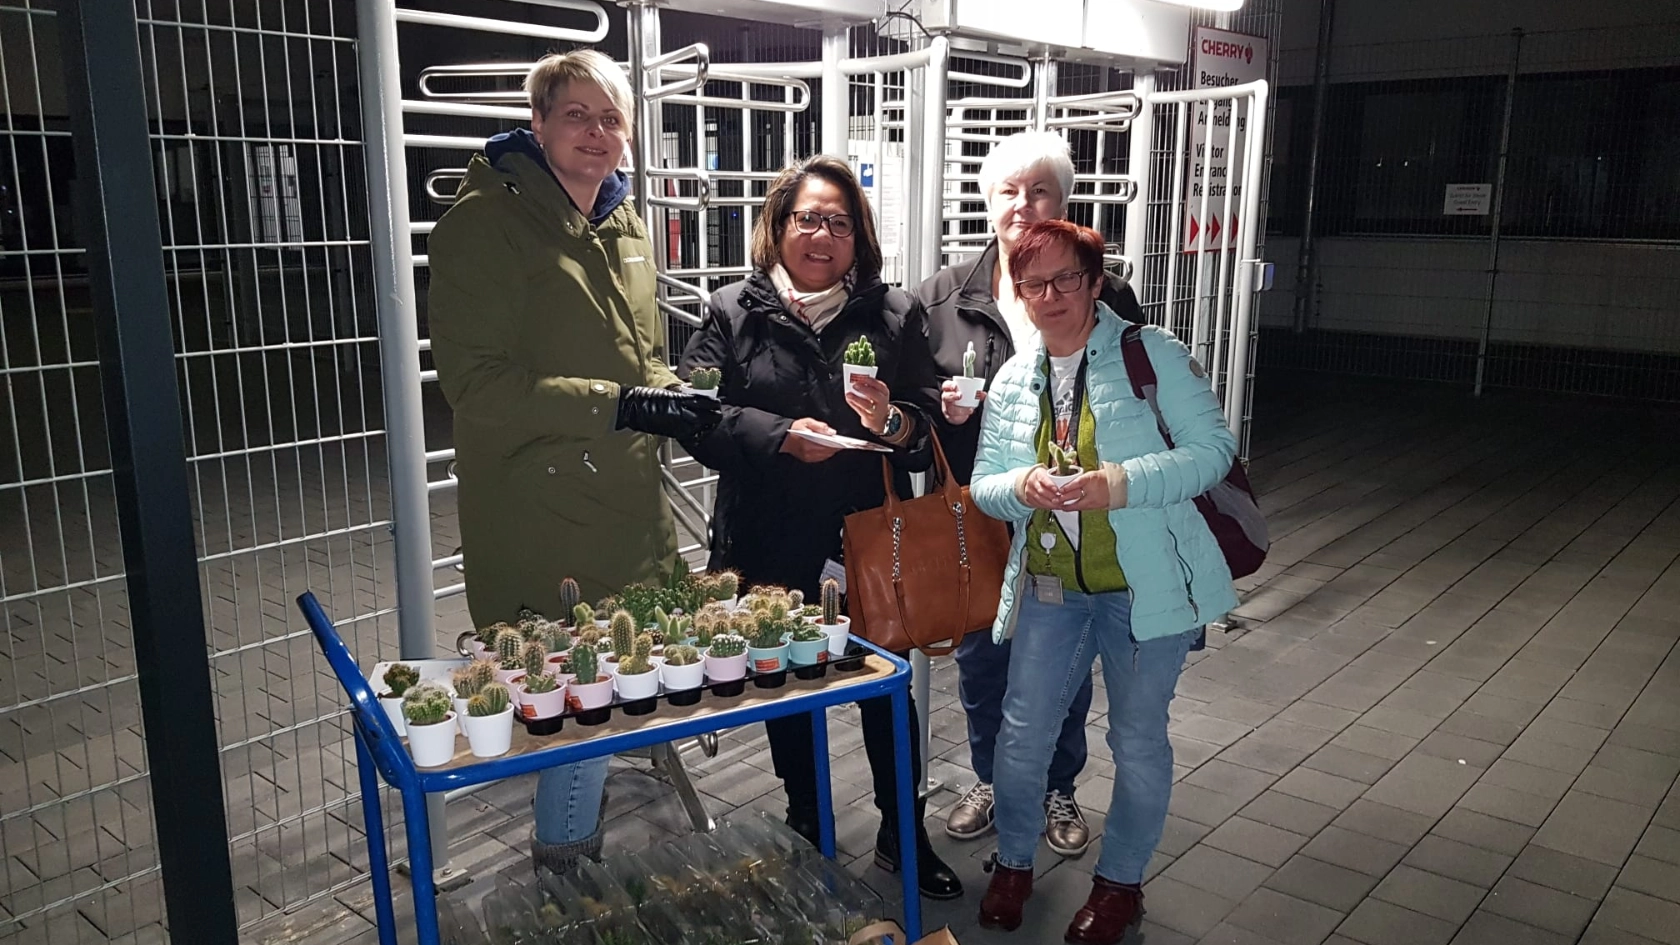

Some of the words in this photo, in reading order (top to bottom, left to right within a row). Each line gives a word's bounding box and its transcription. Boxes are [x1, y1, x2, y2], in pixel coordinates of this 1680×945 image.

[1202, 39, 1244, 59] CHERRY
[1200, 71, 1239, 87] Besucher
[1198, 110, 1246, 132] Aeldg
[1196, 143, 1224, 158] Vitor
[1194, 163, 1228, 177] Enranc
[1193, 182, 1242, 197] Reistraon
